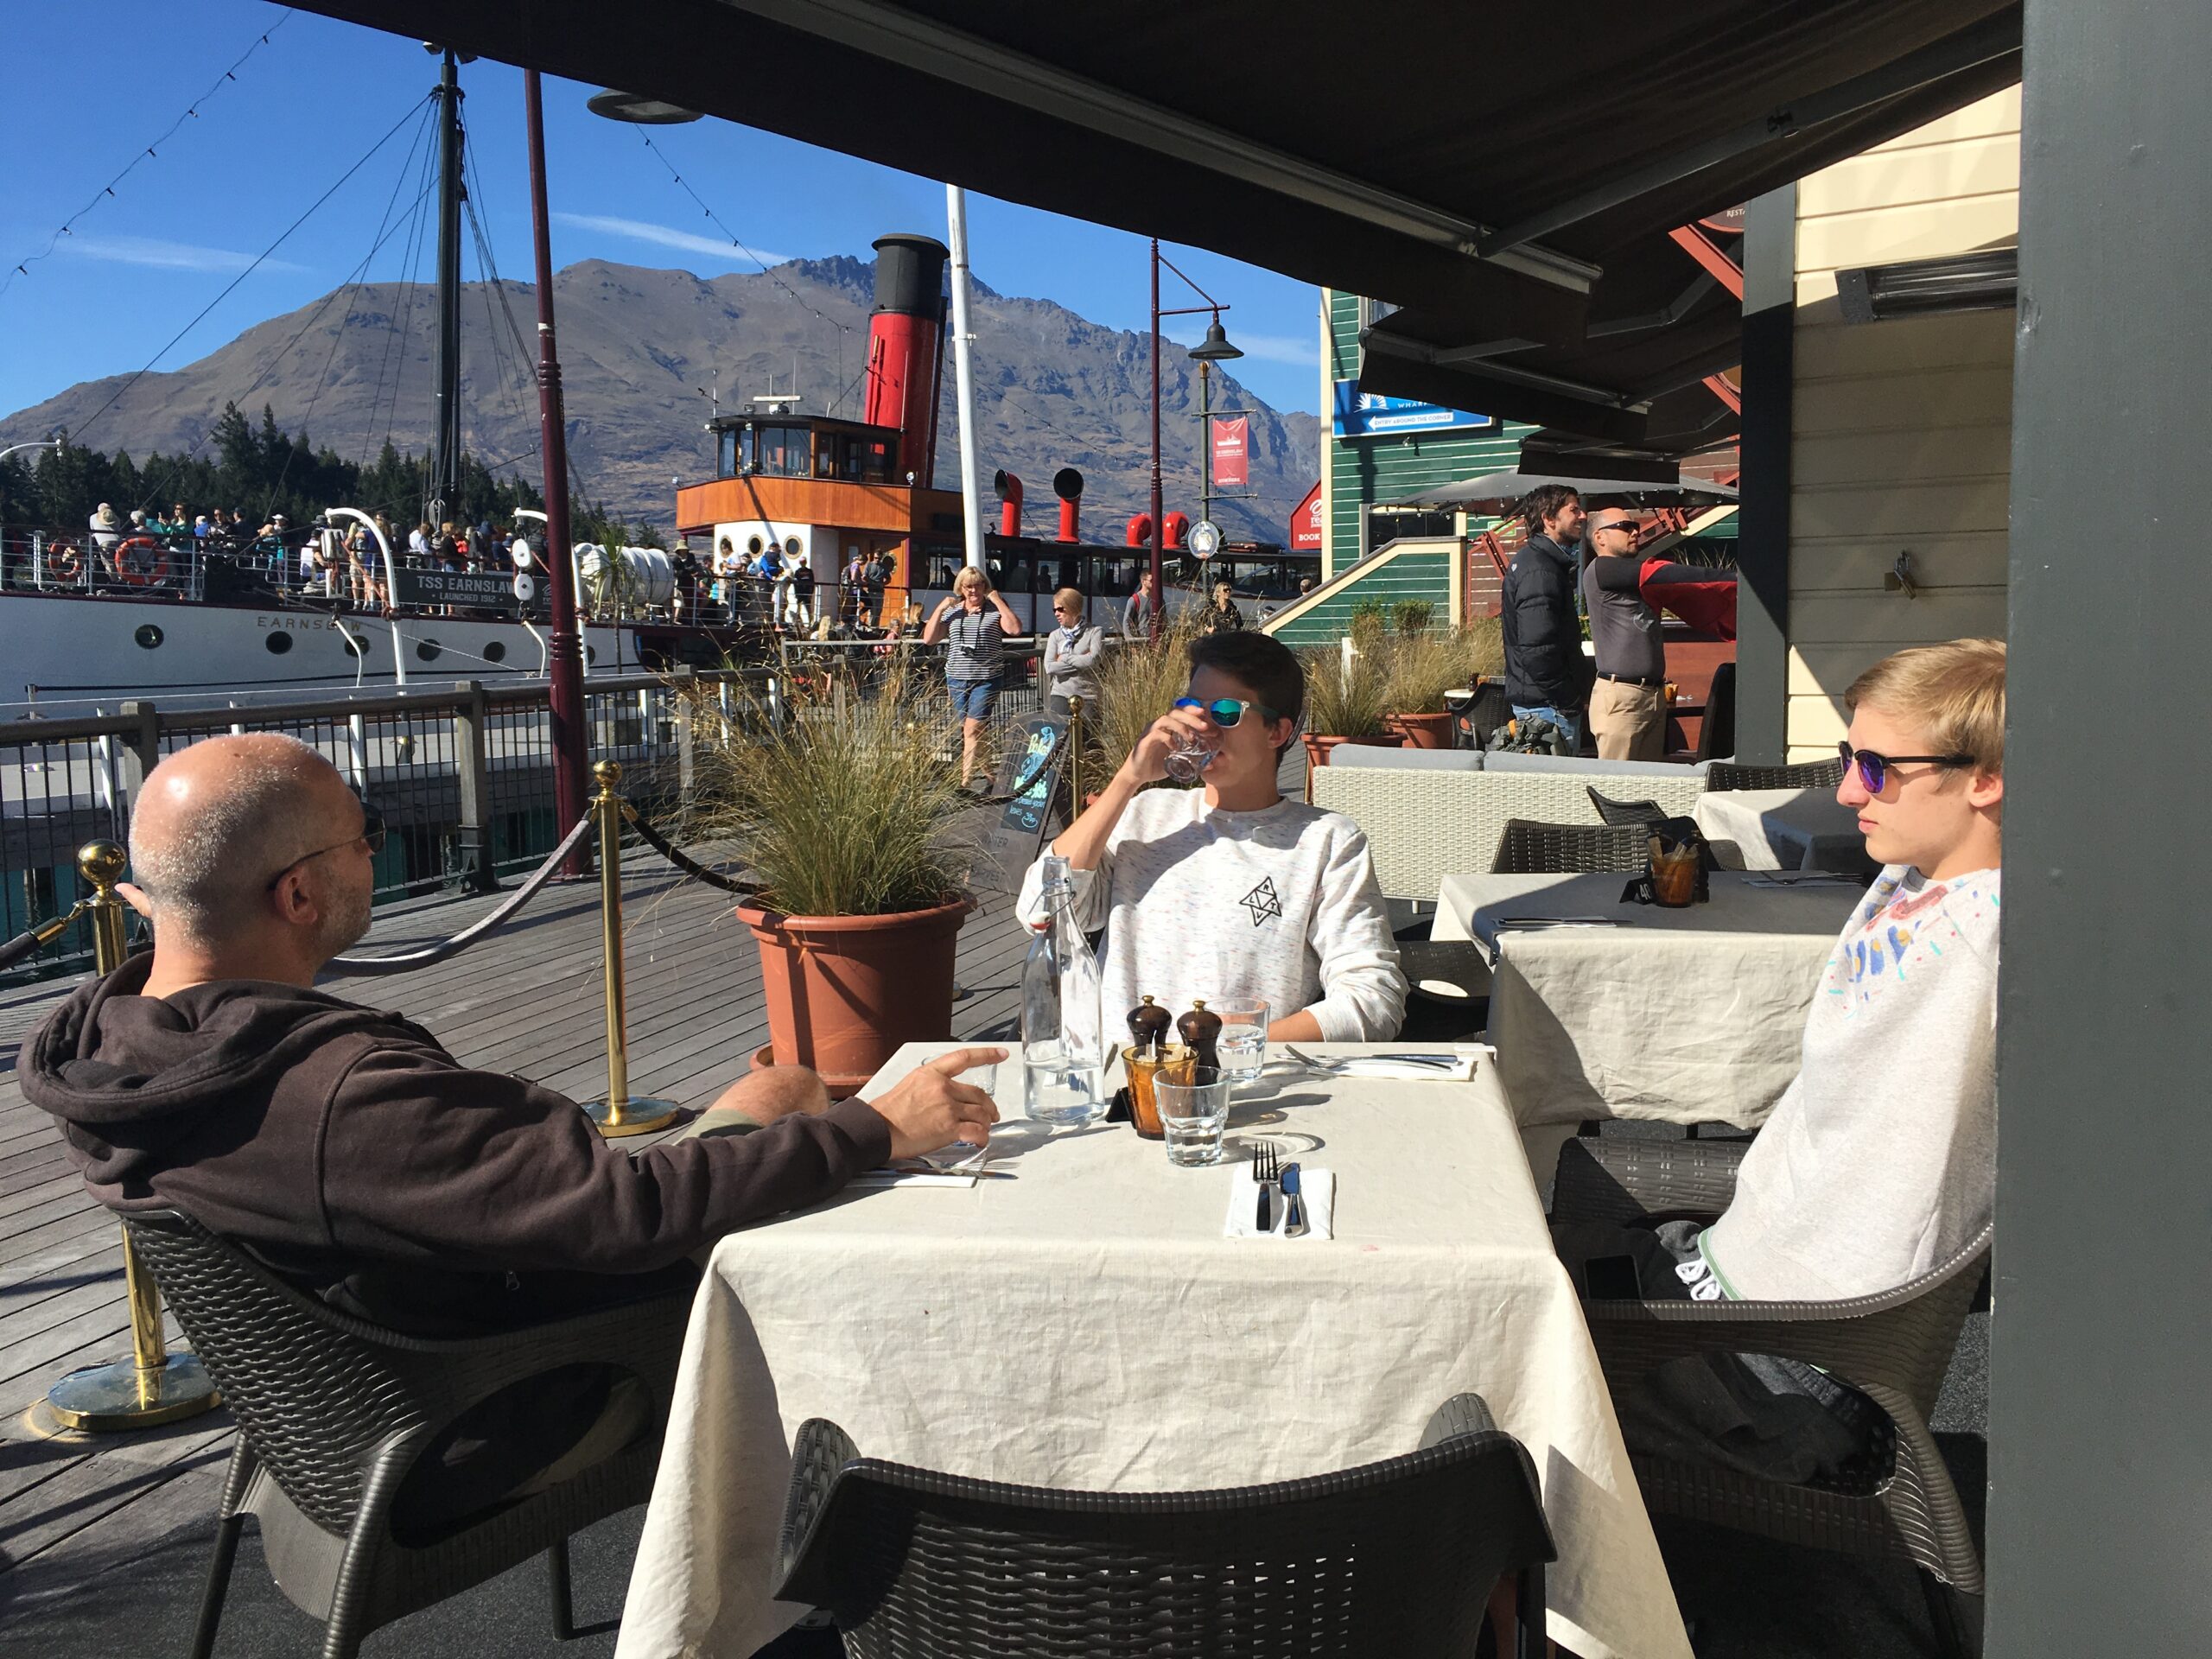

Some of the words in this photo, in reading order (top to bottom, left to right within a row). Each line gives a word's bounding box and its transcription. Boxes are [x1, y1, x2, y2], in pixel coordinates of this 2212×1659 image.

[417, 575, 442, 589] TSS
[448, 578, 516, 593] EARNSLAW
[439, 593, 479, 602] LAUNCHED
[480, 594, 496, 603] 1912
